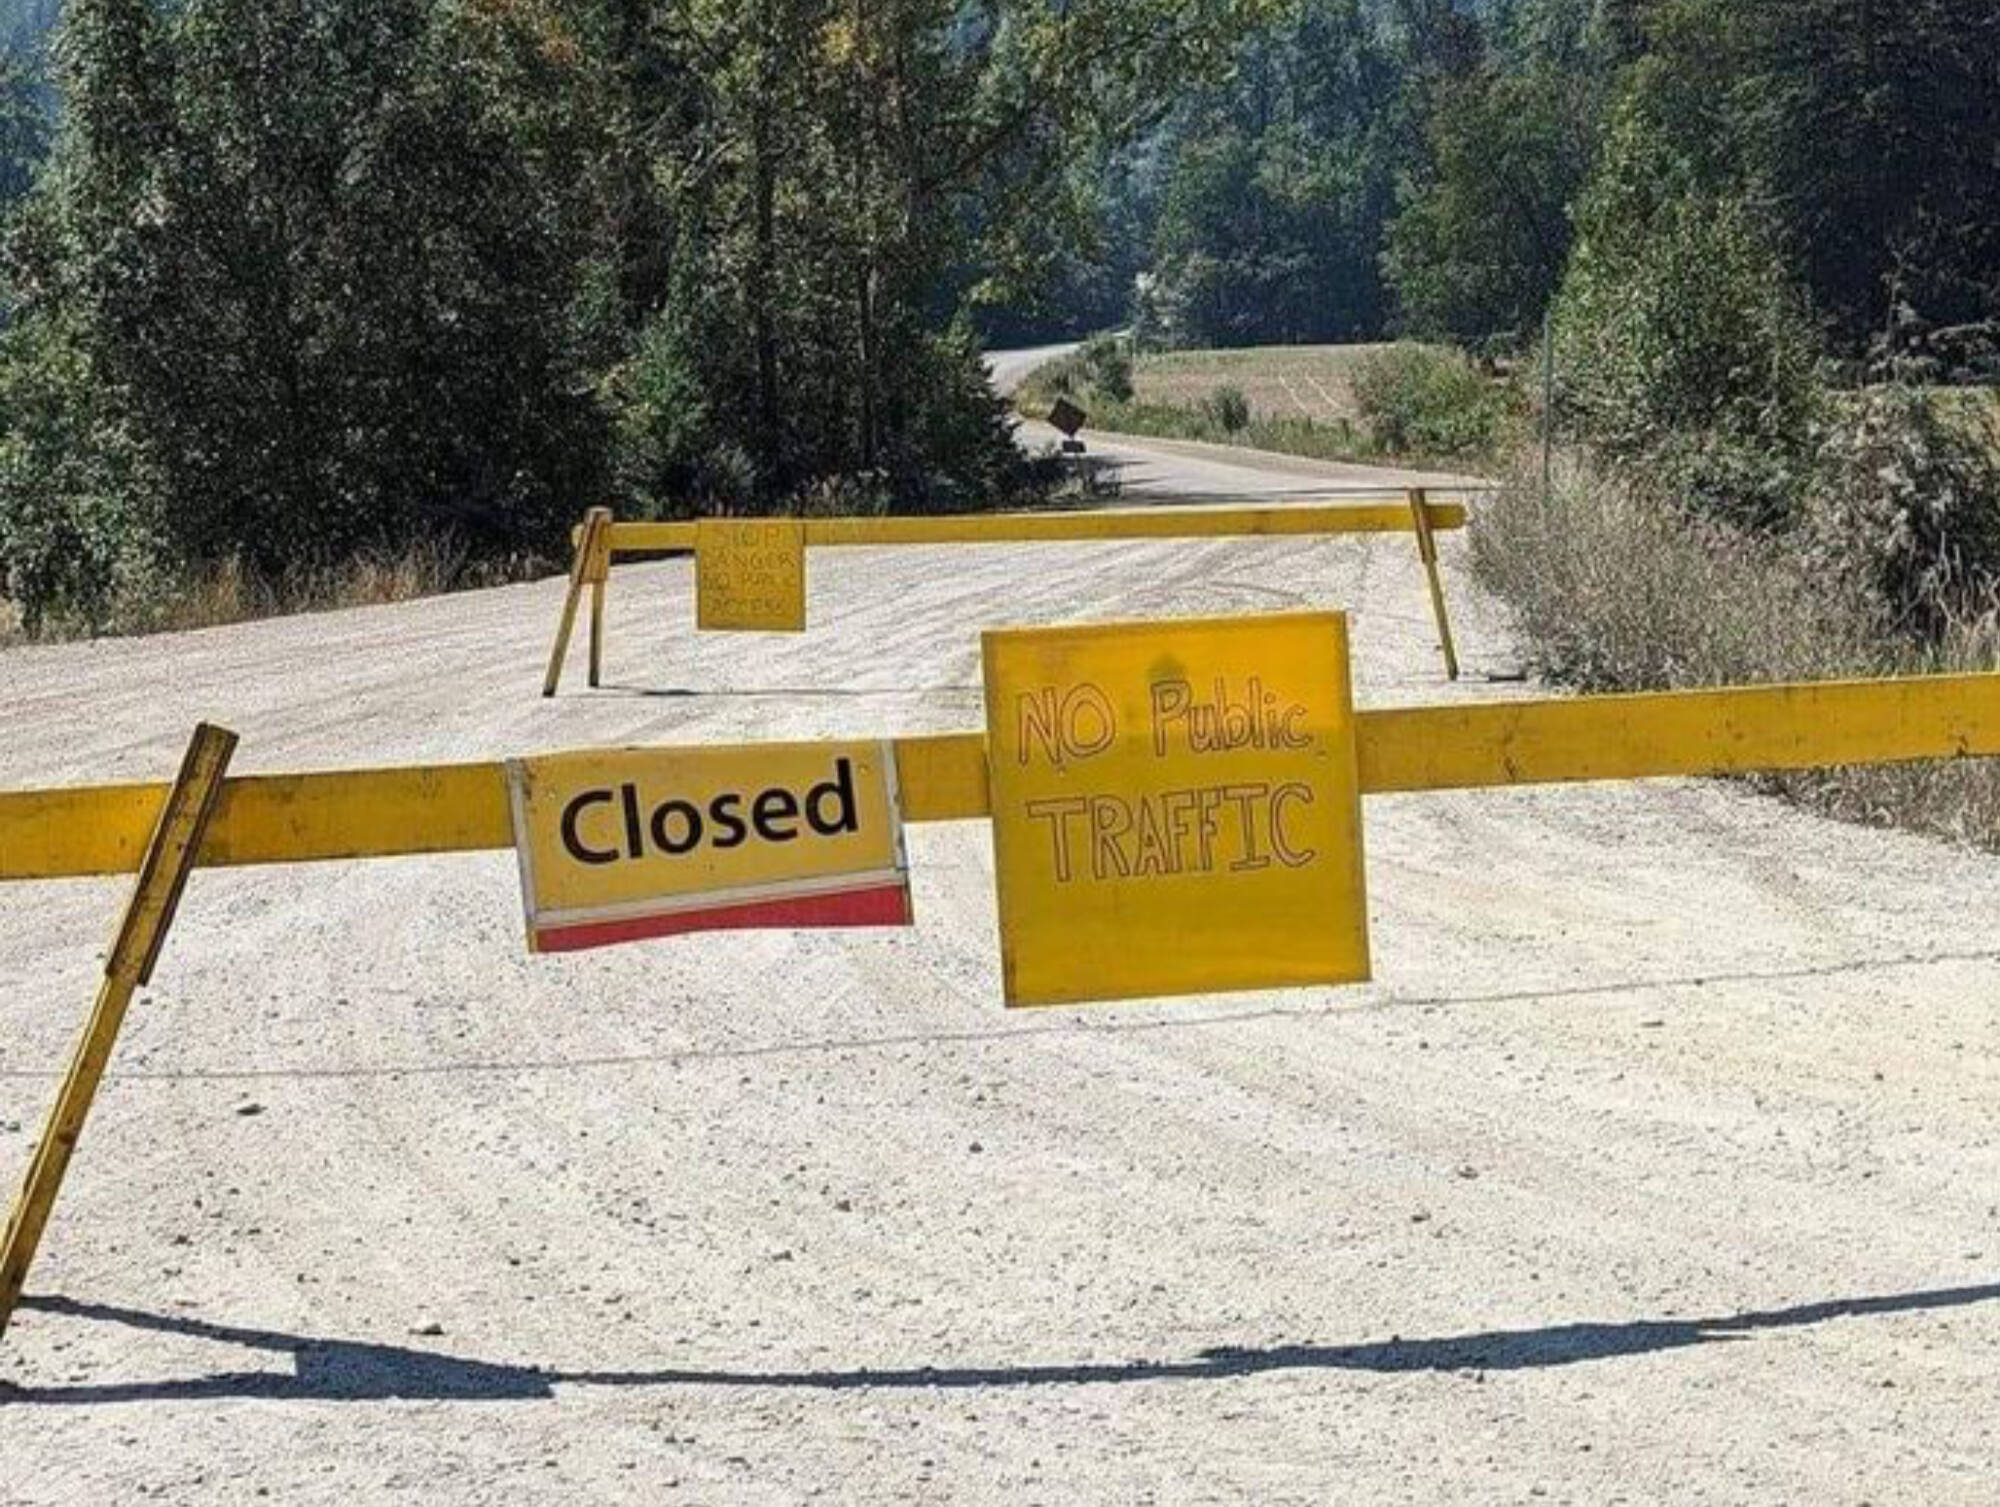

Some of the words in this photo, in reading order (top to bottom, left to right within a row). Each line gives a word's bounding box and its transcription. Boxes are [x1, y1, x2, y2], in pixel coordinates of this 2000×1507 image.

[1017, 682, 1116, 766] NO
[1151, 676, 1314, 757] Public
[560, 758, 859, 864] Closed
[1026, 782, 1314, 882] TRAFFIC
